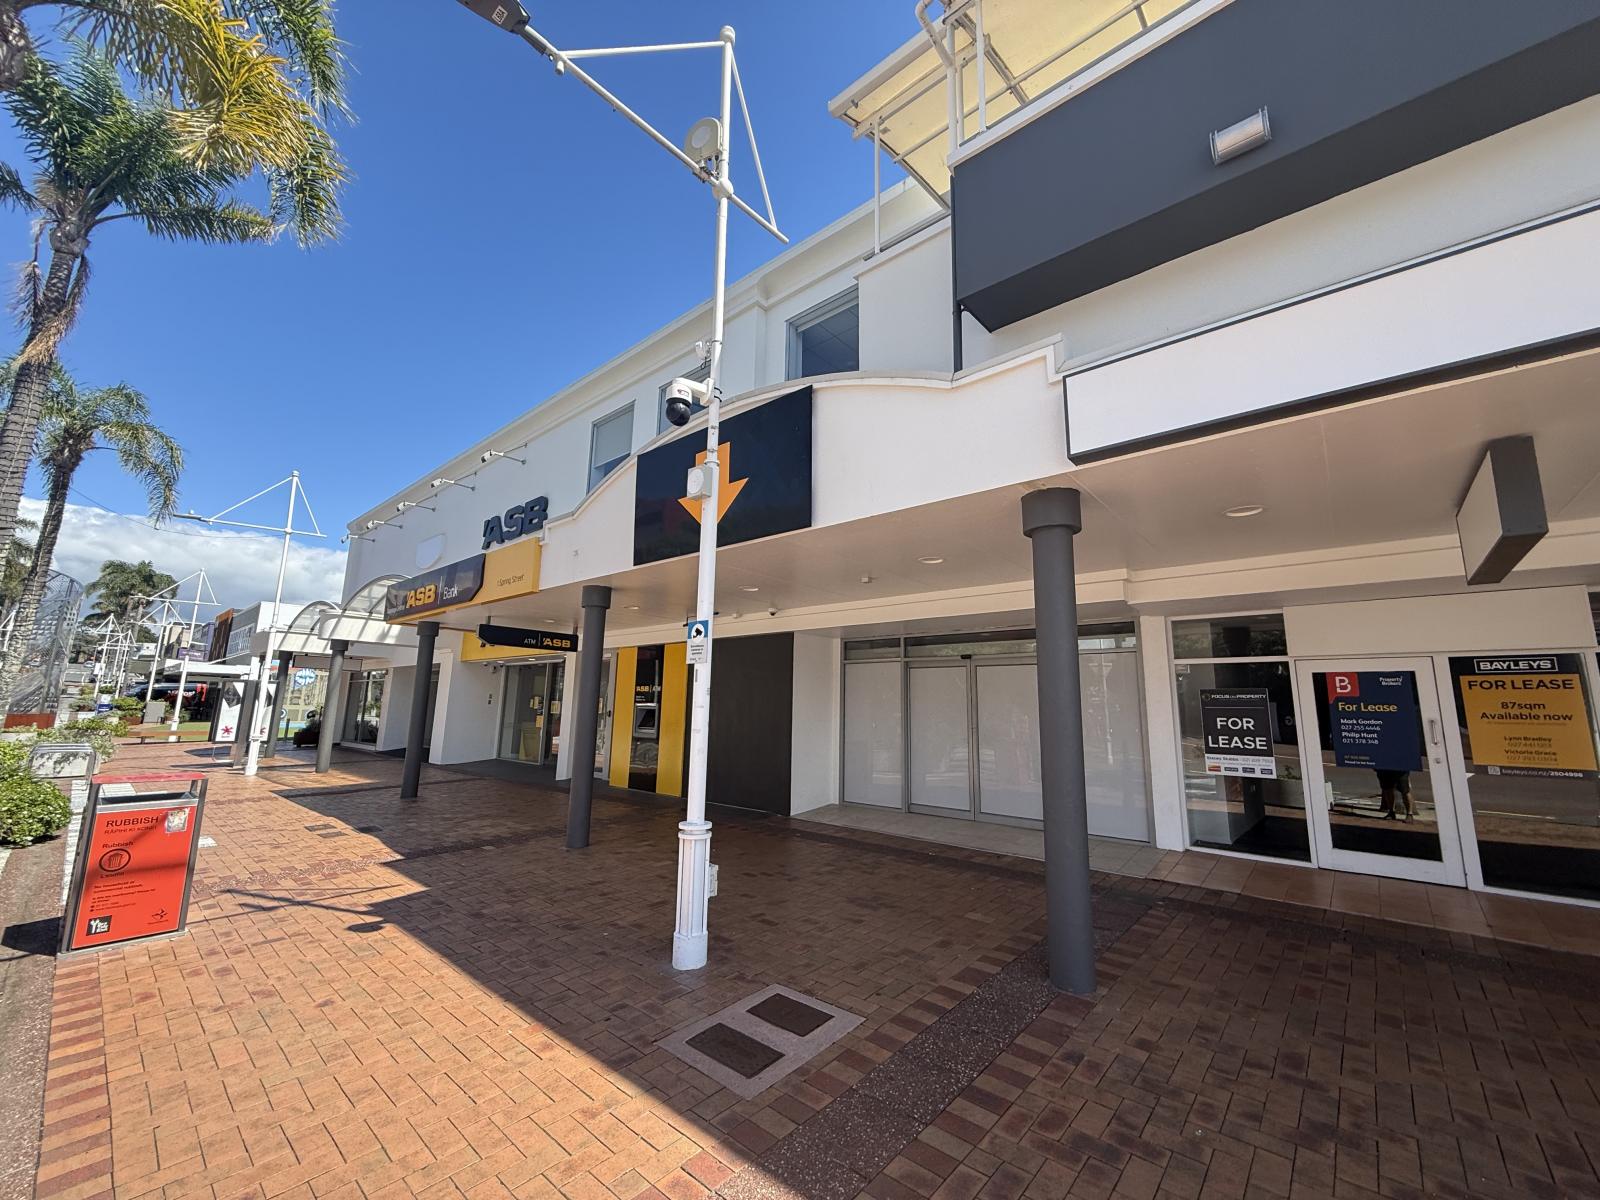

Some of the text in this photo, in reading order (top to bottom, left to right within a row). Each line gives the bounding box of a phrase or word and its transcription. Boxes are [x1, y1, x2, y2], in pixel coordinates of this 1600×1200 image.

[443, 584, 458, 600] Bank
[1480, 660, 1552, 670] BAYLEYS
[1335, 676, 1352, 693] B
[1468, 680, 1575, 690] FOR LEASE
[1337, 701, 1398, 712] For Lease
[1500, 701, 1546, 710] 87sqm
[1480, 711, 1573, 721] Available now
[1216, 717, 1255, 730] FOR
[1208, 735, 1268, 750] LEASE
[106, 816, 159, 828] RUBBISH
[102, 840, 134, 849] Rubbish
